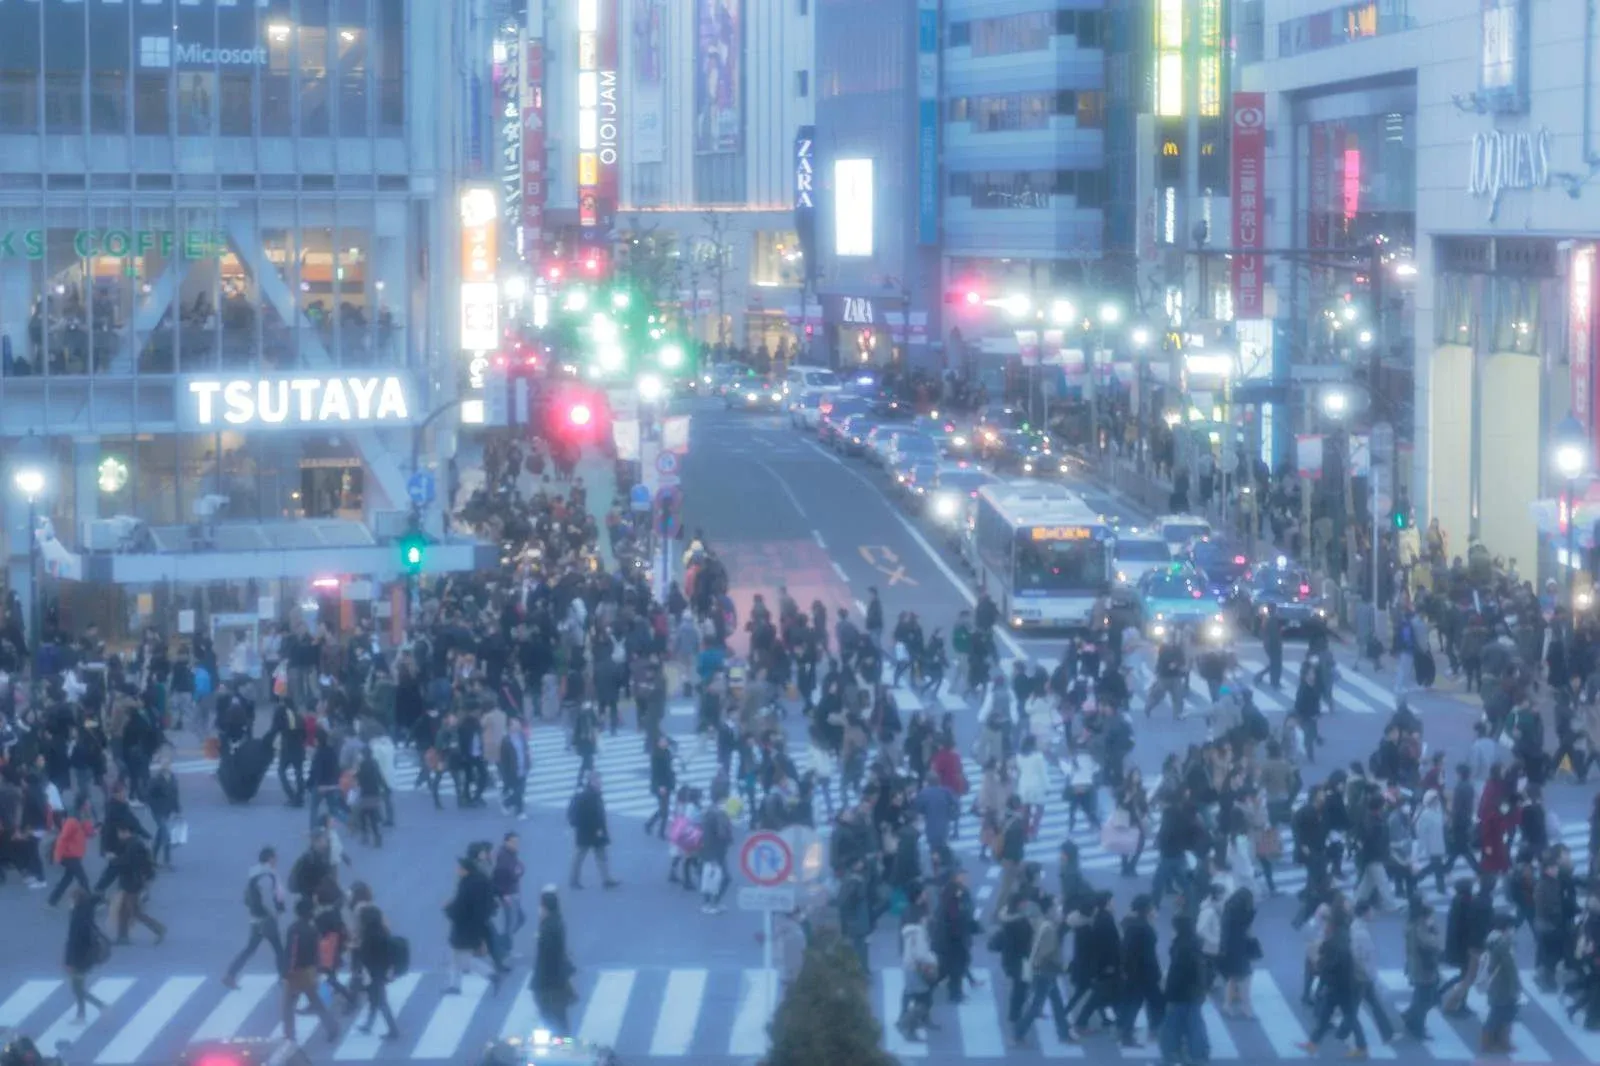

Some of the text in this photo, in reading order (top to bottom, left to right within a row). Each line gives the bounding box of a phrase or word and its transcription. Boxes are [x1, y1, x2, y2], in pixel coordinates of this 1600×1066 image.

[176, 43, 268, 66] Microsoft
[599, 70, 617, 115] JAM
[796, 139, 814, 208] ZARA
[74, 229, 228, 260] COFFEE
[843, 297, 873, 323] ZARA
[190, 376, 408, 424] TSUTAYA
